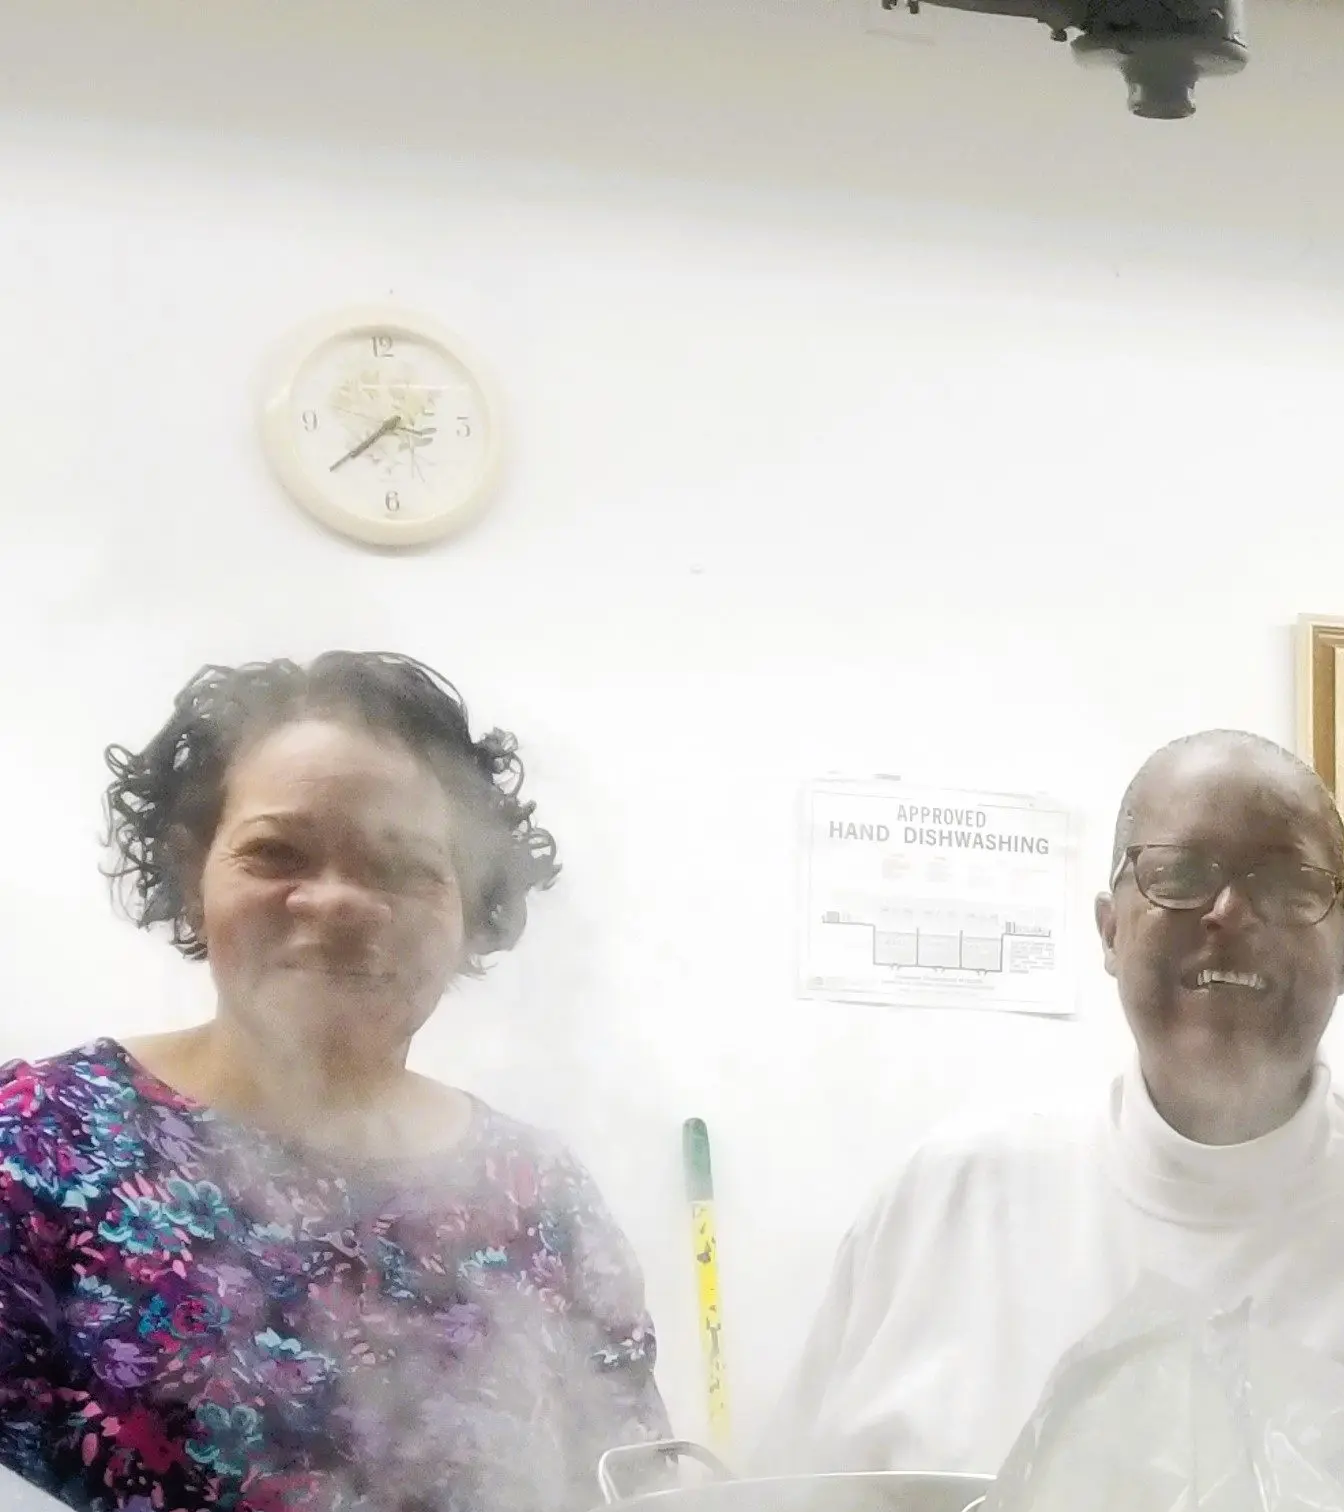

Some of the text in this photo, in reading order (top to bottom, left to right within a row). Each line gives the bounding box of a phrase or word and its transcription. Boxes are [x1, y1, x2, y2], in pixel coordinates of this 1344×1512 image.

[371, 335, 395, 357] 12
[302, 409, 318, 432] 9
[385, 490, 401, 513] 6
[897, 804, 986, 828] APPROVED
[828, 821, 1050, 855] HAND DISHWASHING
